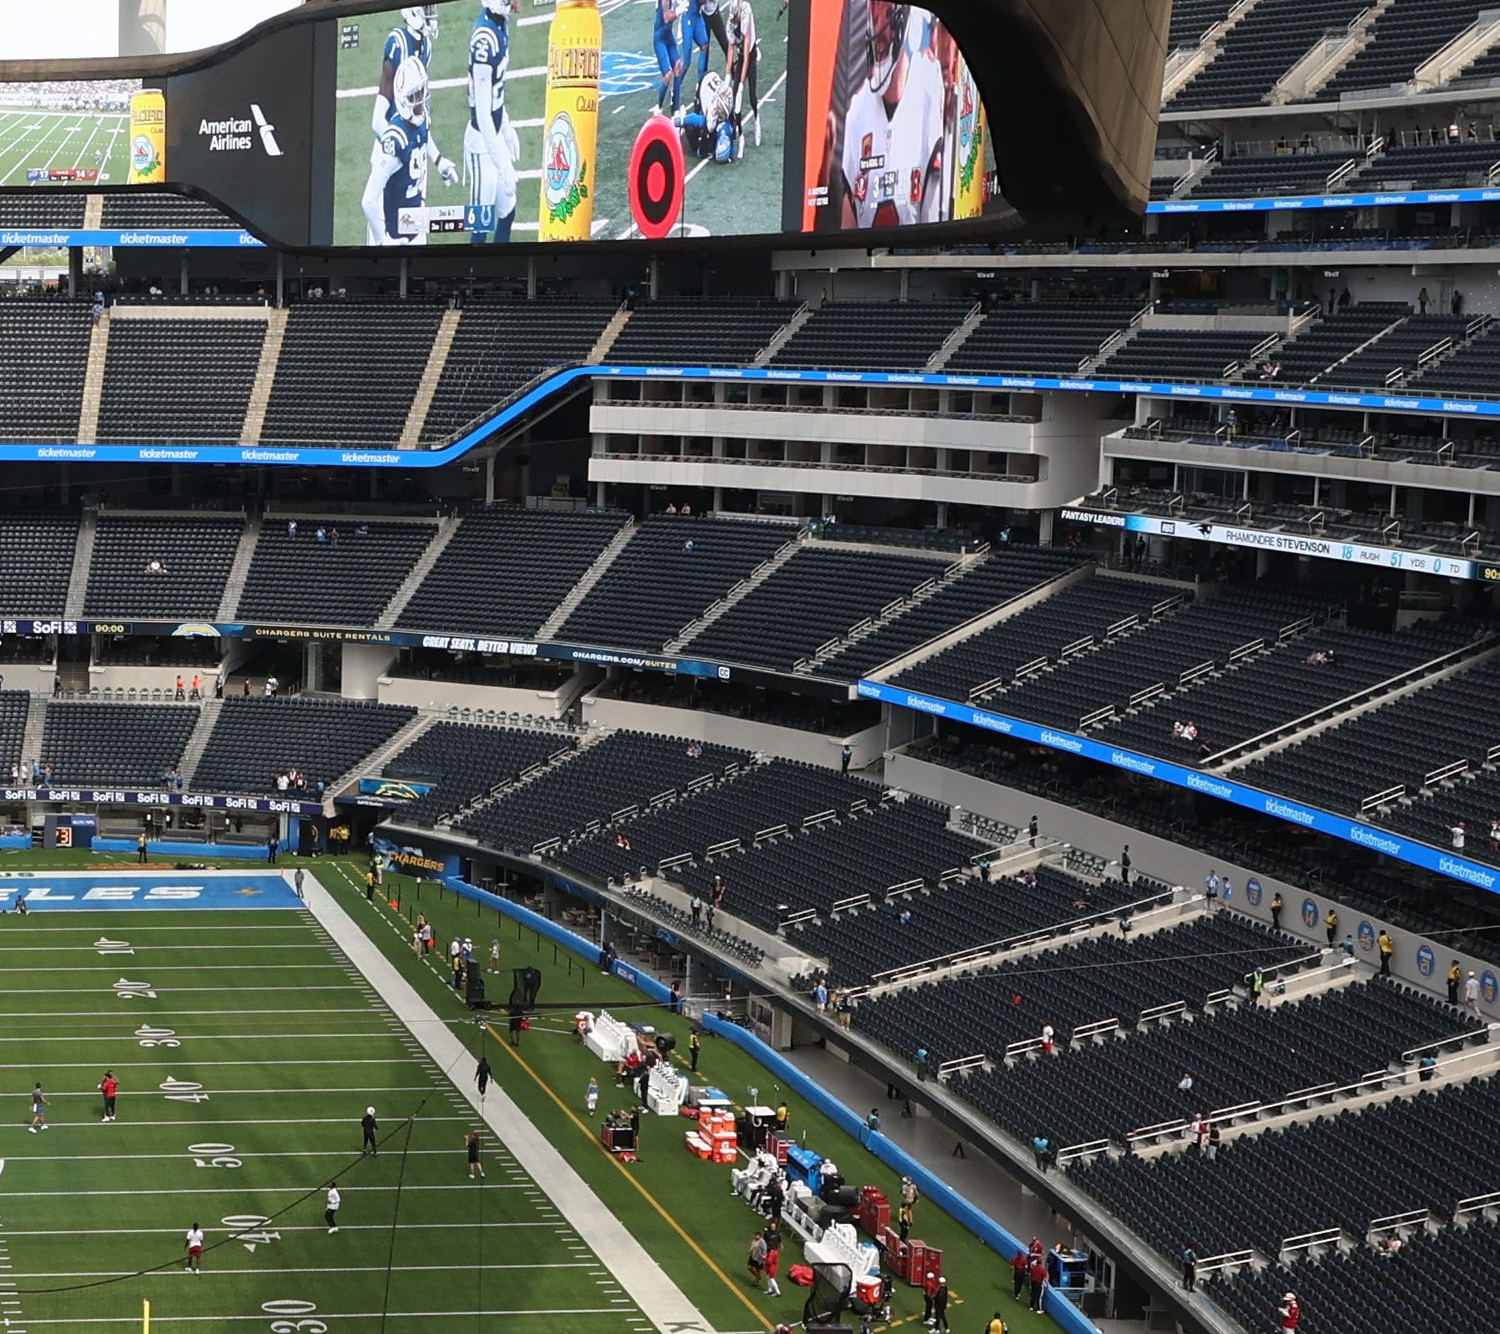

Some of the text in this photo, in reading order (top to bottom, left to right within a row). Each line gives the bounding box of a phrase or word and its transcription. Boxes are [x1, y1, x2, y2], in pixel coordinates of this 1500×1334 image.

[199, 116, 252, 135] American
[210, 134, 252, 151] Airlines
[0, 232, 72, 246] ticketmaster
[138, 448, 200, 459] ticketmaster
[340, 452, 402, 464] ticketmaster
[1060, 514, 1126, 532] FANTASY LEADERS
[1225, 530, 1331, 555] RHAMONDRE STEVENSON
[1341, 544, 1353, 560] 18
[1390, 551, 1404, 568] 51
[1409, 557, 1426, 569] YDS
[1432, 557, 1442, 573] 0
[1448, 563, 1461, 573] TD
[32, 620, 62, 634] SoFi
[95, 624, 124, 634] 90:00
[256, 628, 391, 642] CHARGERS SUITE RENTALS
[423, 635, 448, 650] GREAT
[477, 639, 509, 654] BETTER
[510, 642, 538, 656] VIEWS
[572, 650, 677, 670] CHARGERS.COM/SUITES
[49, 790, 70, 801] SoFi
[226, 797, 246, 808] SoFi
[387, 851, 445, 873] CHARGERS
[1436, 856, 1496, 887] ticketmaster
[158, 1080, 210, 1103] 40
[220, 1214, 282, 1244] 40
